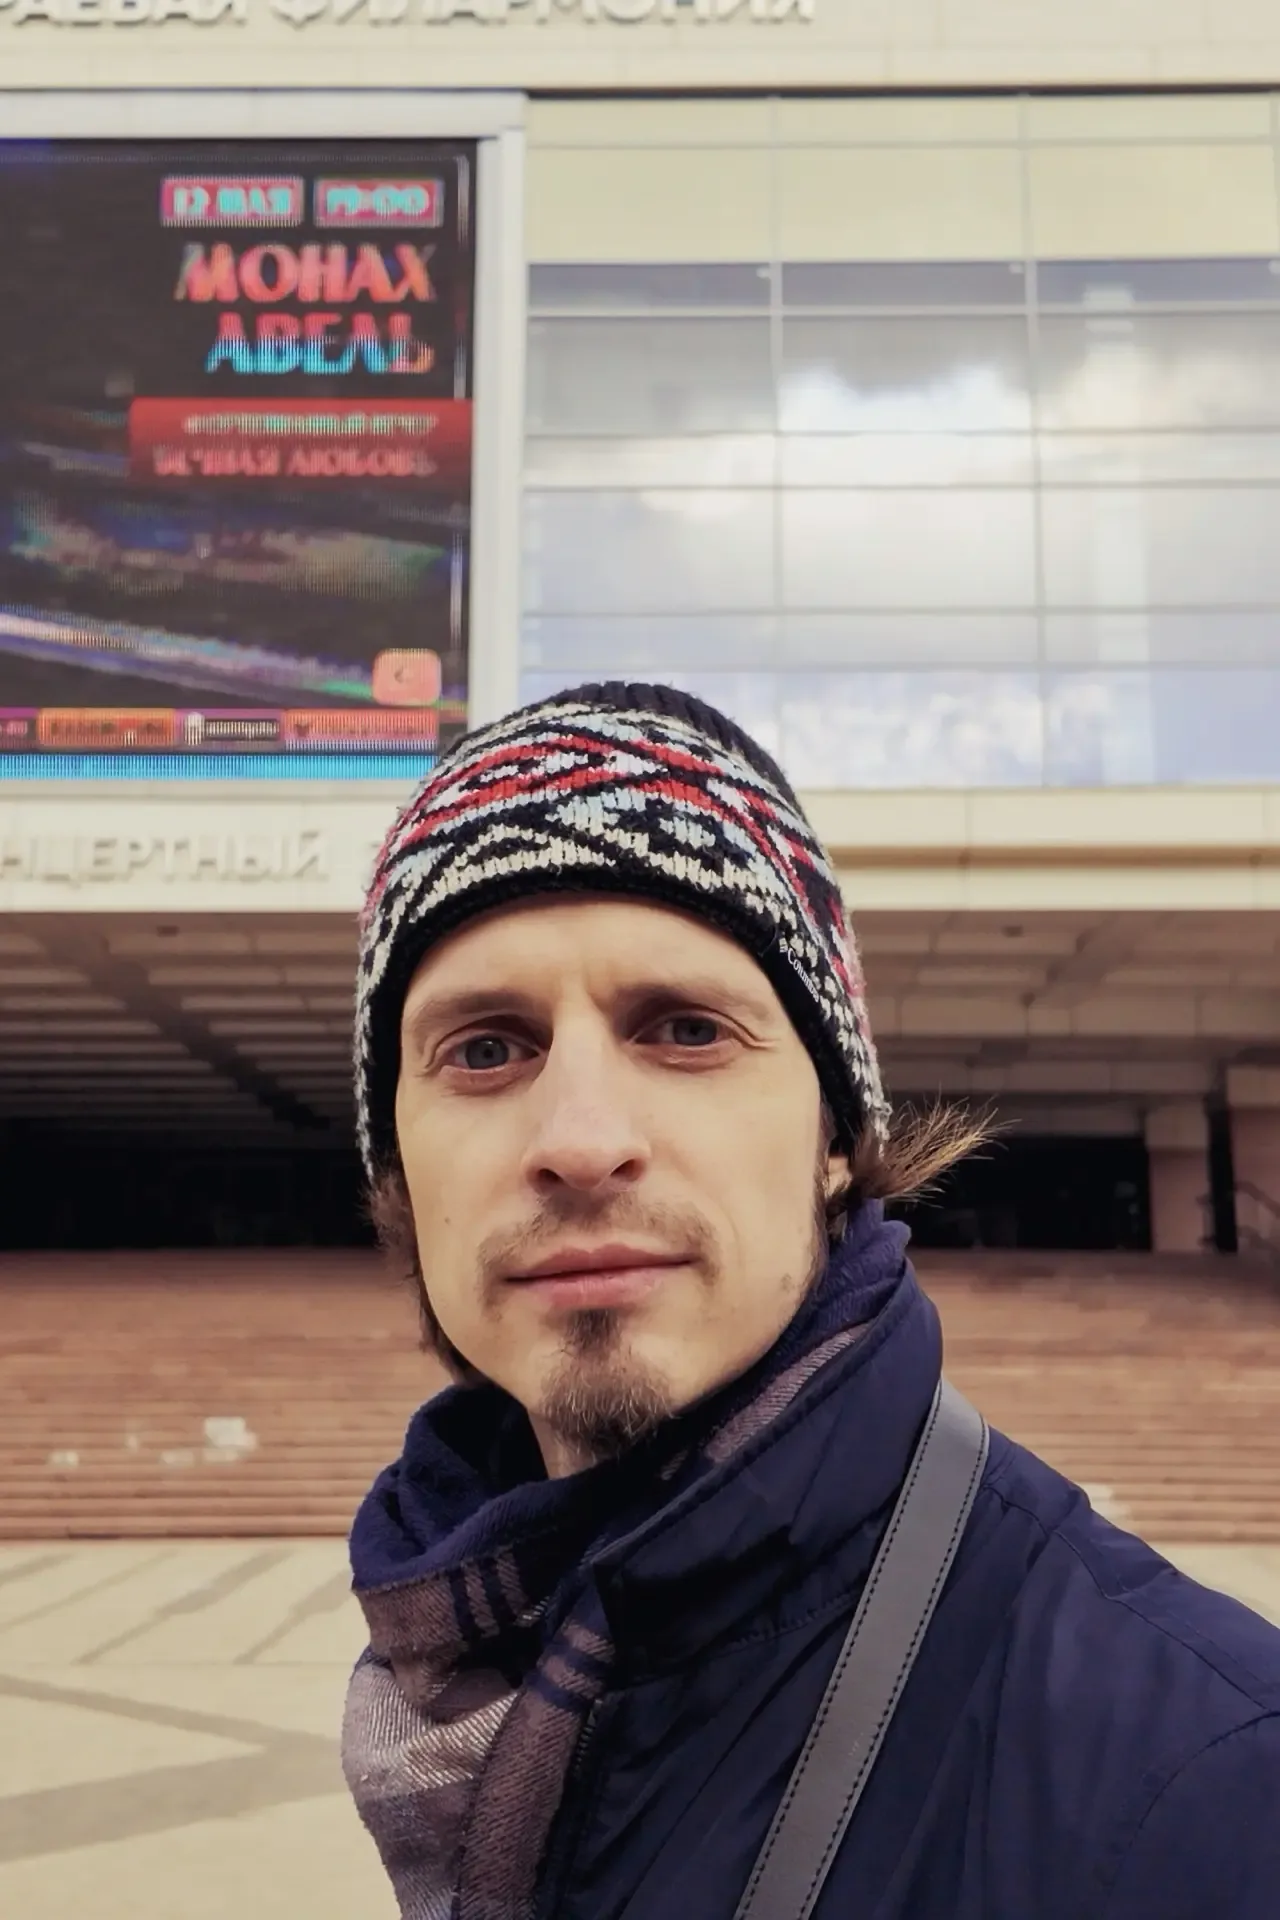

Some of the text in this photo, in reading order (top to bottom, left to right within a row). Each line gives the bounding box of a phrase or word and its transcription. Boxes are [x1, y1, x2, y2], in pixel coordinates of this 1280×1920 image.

[0, 0, 243, 26] АЕВАЯ
[175, 241, 437, 303] МОНАХ
[205, 312, 435, 374] АВЕЛЬ
